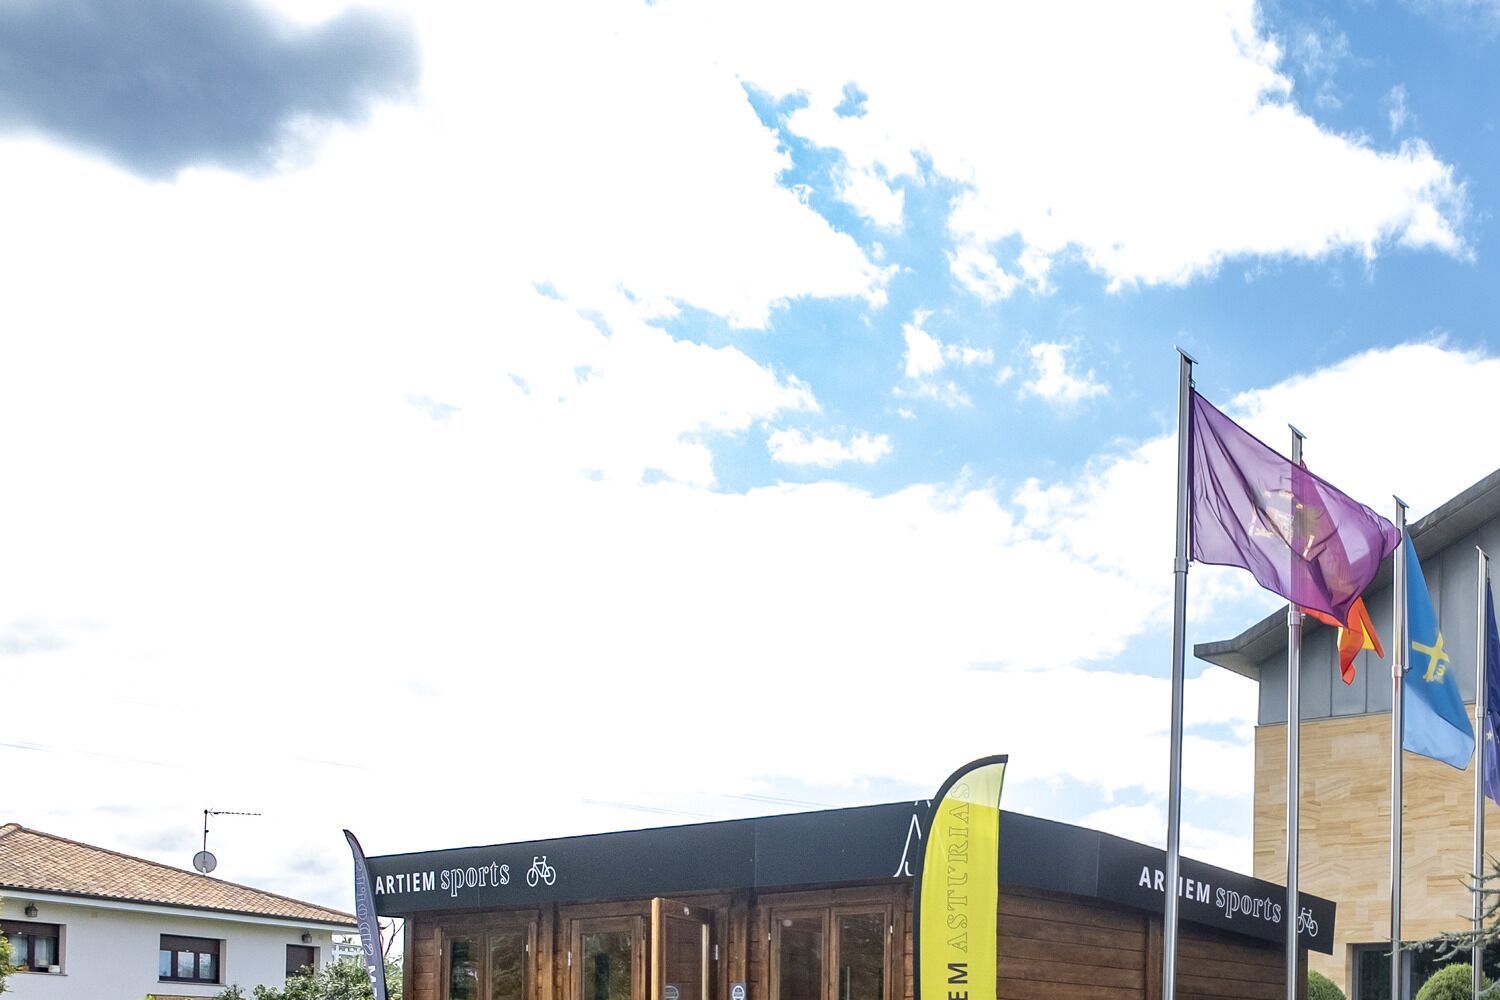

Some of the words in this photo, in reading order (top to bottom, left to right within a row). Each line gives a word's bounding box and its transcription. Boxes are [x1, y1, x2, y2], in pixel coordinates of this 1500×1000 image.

[375, 871, 435, 895] ARTIEM
[440, 861, 510, 897] sports
[946, 782, 970, 953] ASTURIAS
[1138, 866, 1211, 904] ARIEM
[1215, 887, 1282, 923] sports
